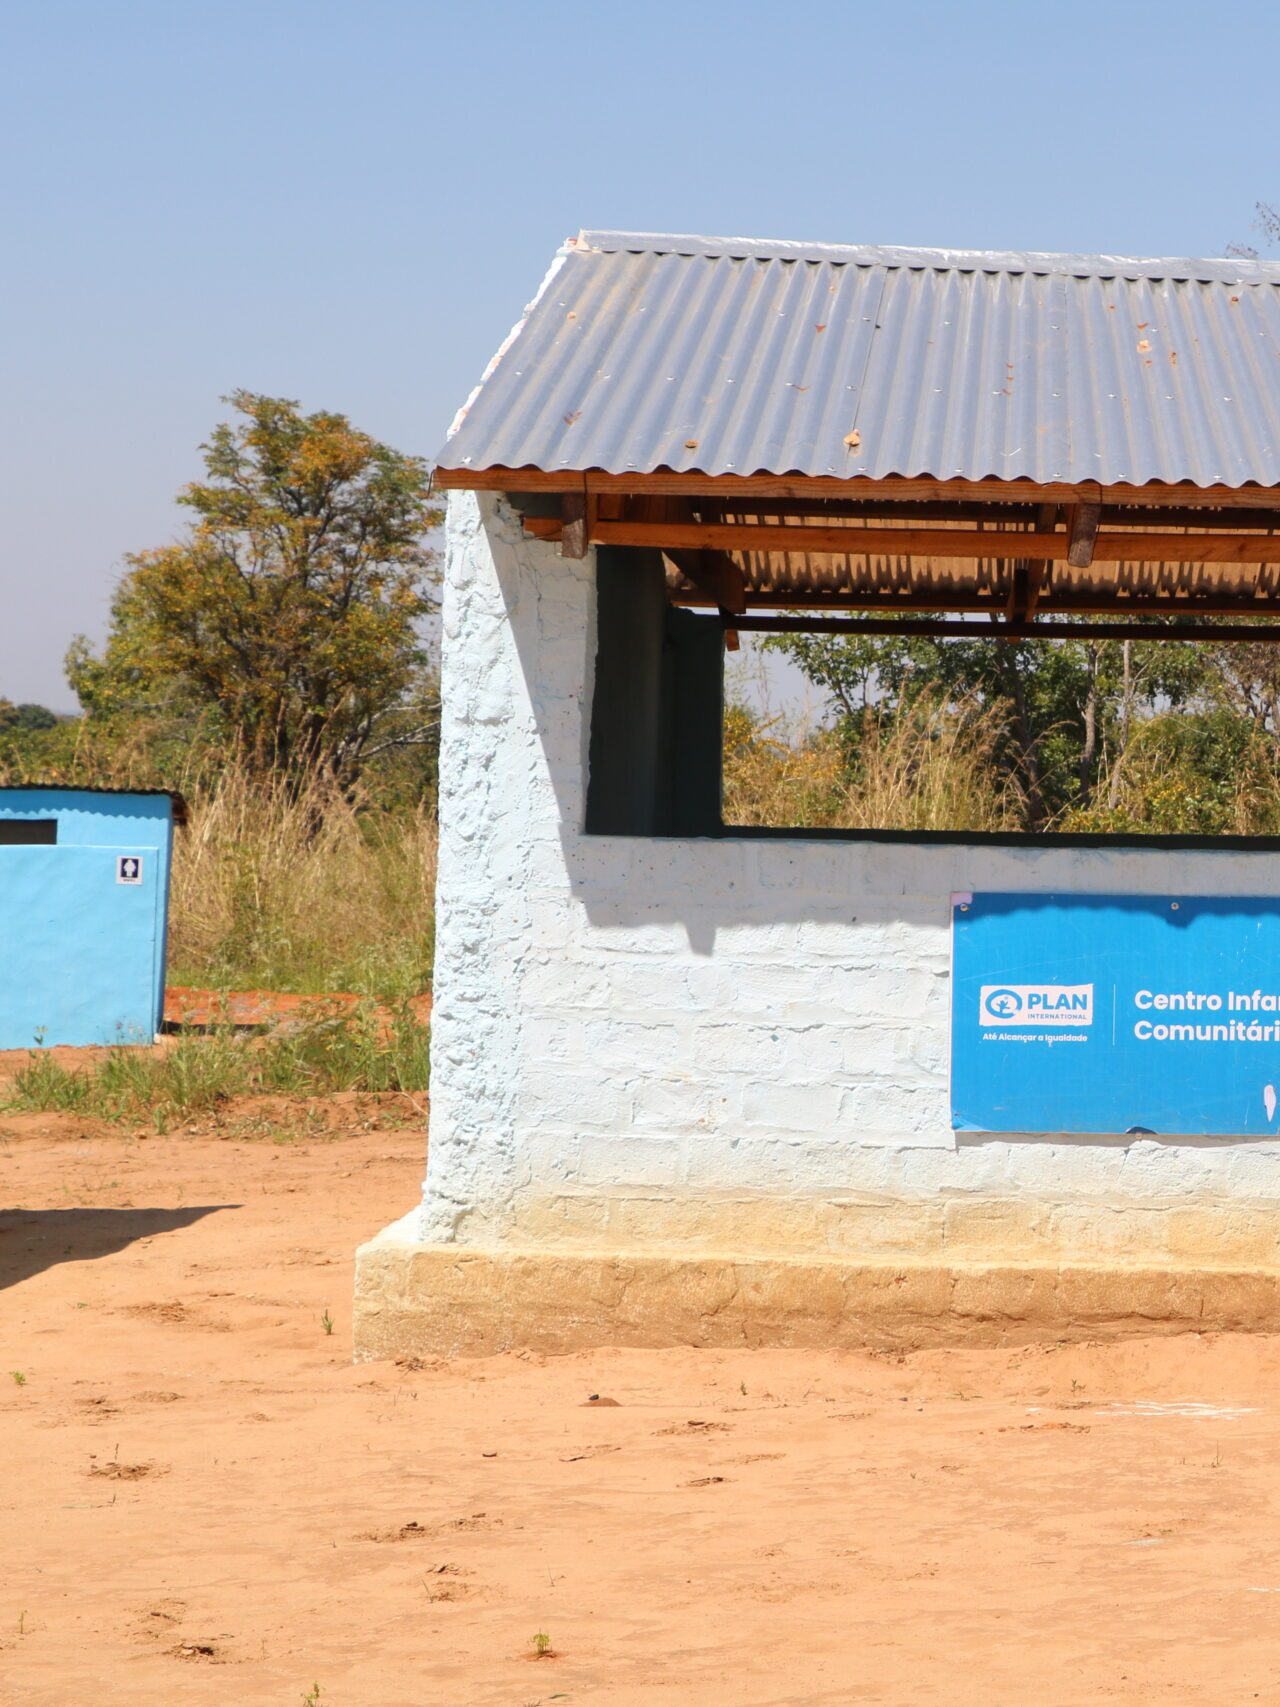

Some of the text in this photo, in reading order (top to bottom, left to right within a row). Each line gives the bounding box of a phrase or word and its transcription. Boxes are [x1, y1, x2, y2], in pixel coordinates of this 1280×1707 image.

[1027, 993, 1088, 1010] PLAN
[1134, 989, 1223, 1010] Centro
[982, 1032, 997, 1041] Até
[998, 1032, 1037, 1043] Alcançar
[1045, 1033, 1088, 1043] Igualdade
